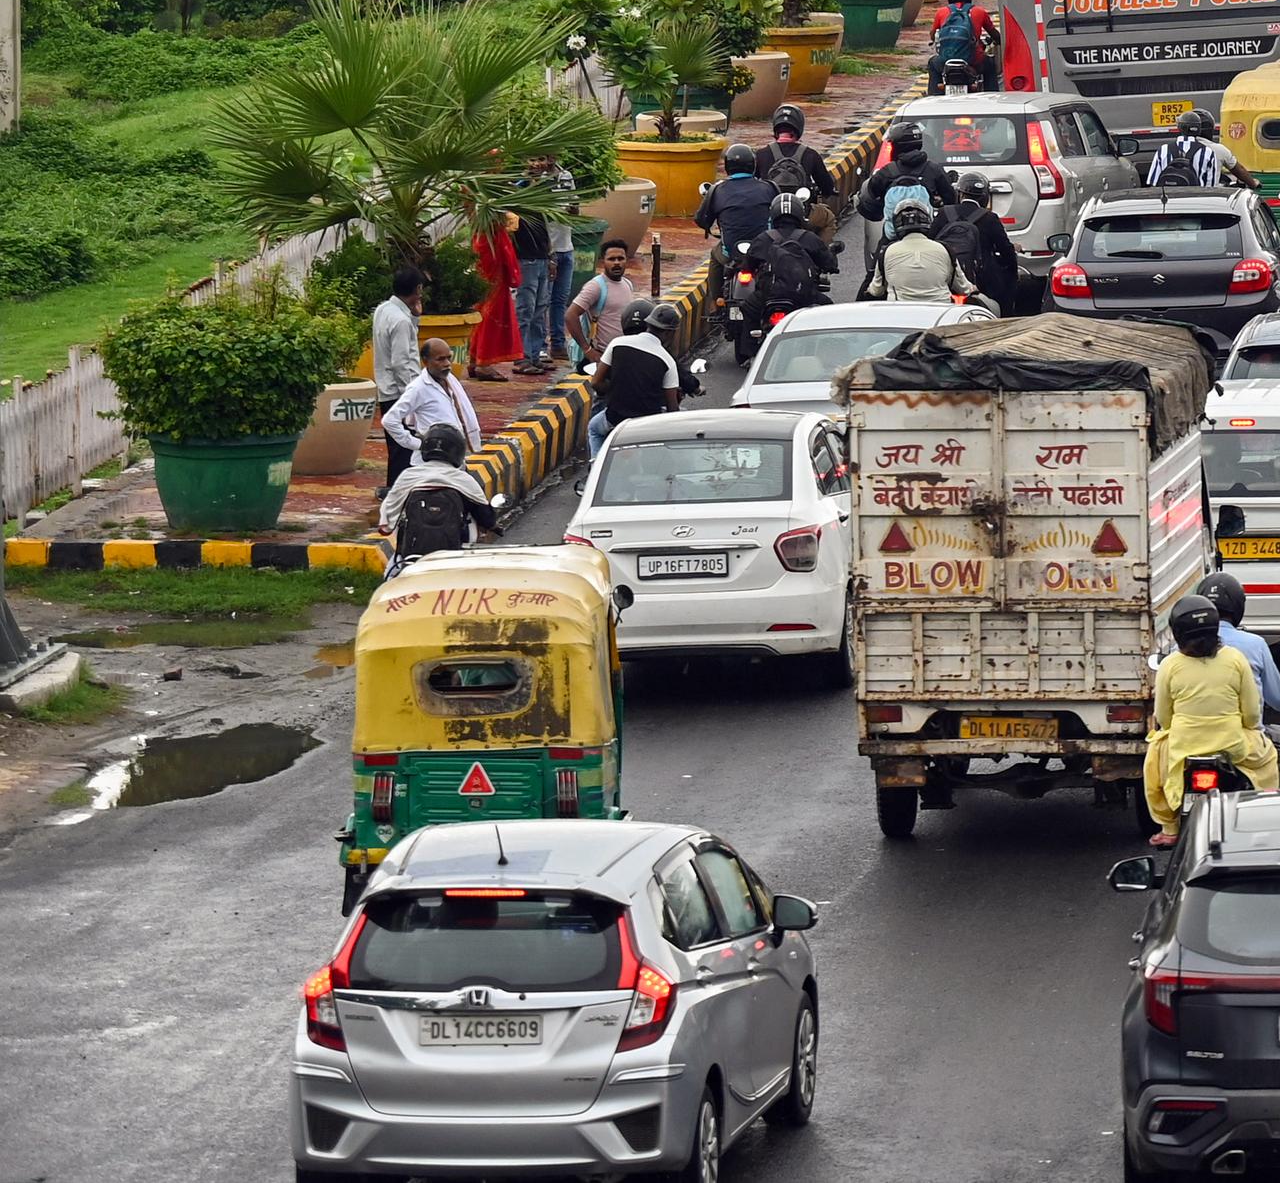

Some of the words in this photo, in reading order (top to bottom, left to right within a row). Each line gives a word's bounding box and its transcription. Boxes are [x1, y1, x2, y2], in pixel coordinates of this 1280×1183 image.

[1073, 49, 1099, 64] THE
[1101, 47, 1140, 62] NAME
[1143, 45, 1159, 60] OF
[1162, 44, 1197, 58] SAFE
[1200, 39, 1260, 58] JOURNEY
[1161, 104, 1183, 114] BR52
[875, 444, 925, 469] जय
[930, 438, 968, 468] श्री
[1036, 445, 1089, 470] राम
[732, 524, 760, 536] Jaat
[648, 557, 724, 574] UP16FT7805
[885, 560, 984, 588] BLOW
[970, 720, 1057, 738] DL1LAF5472
[431, 1021, 540, 1040] DL14CC6609
